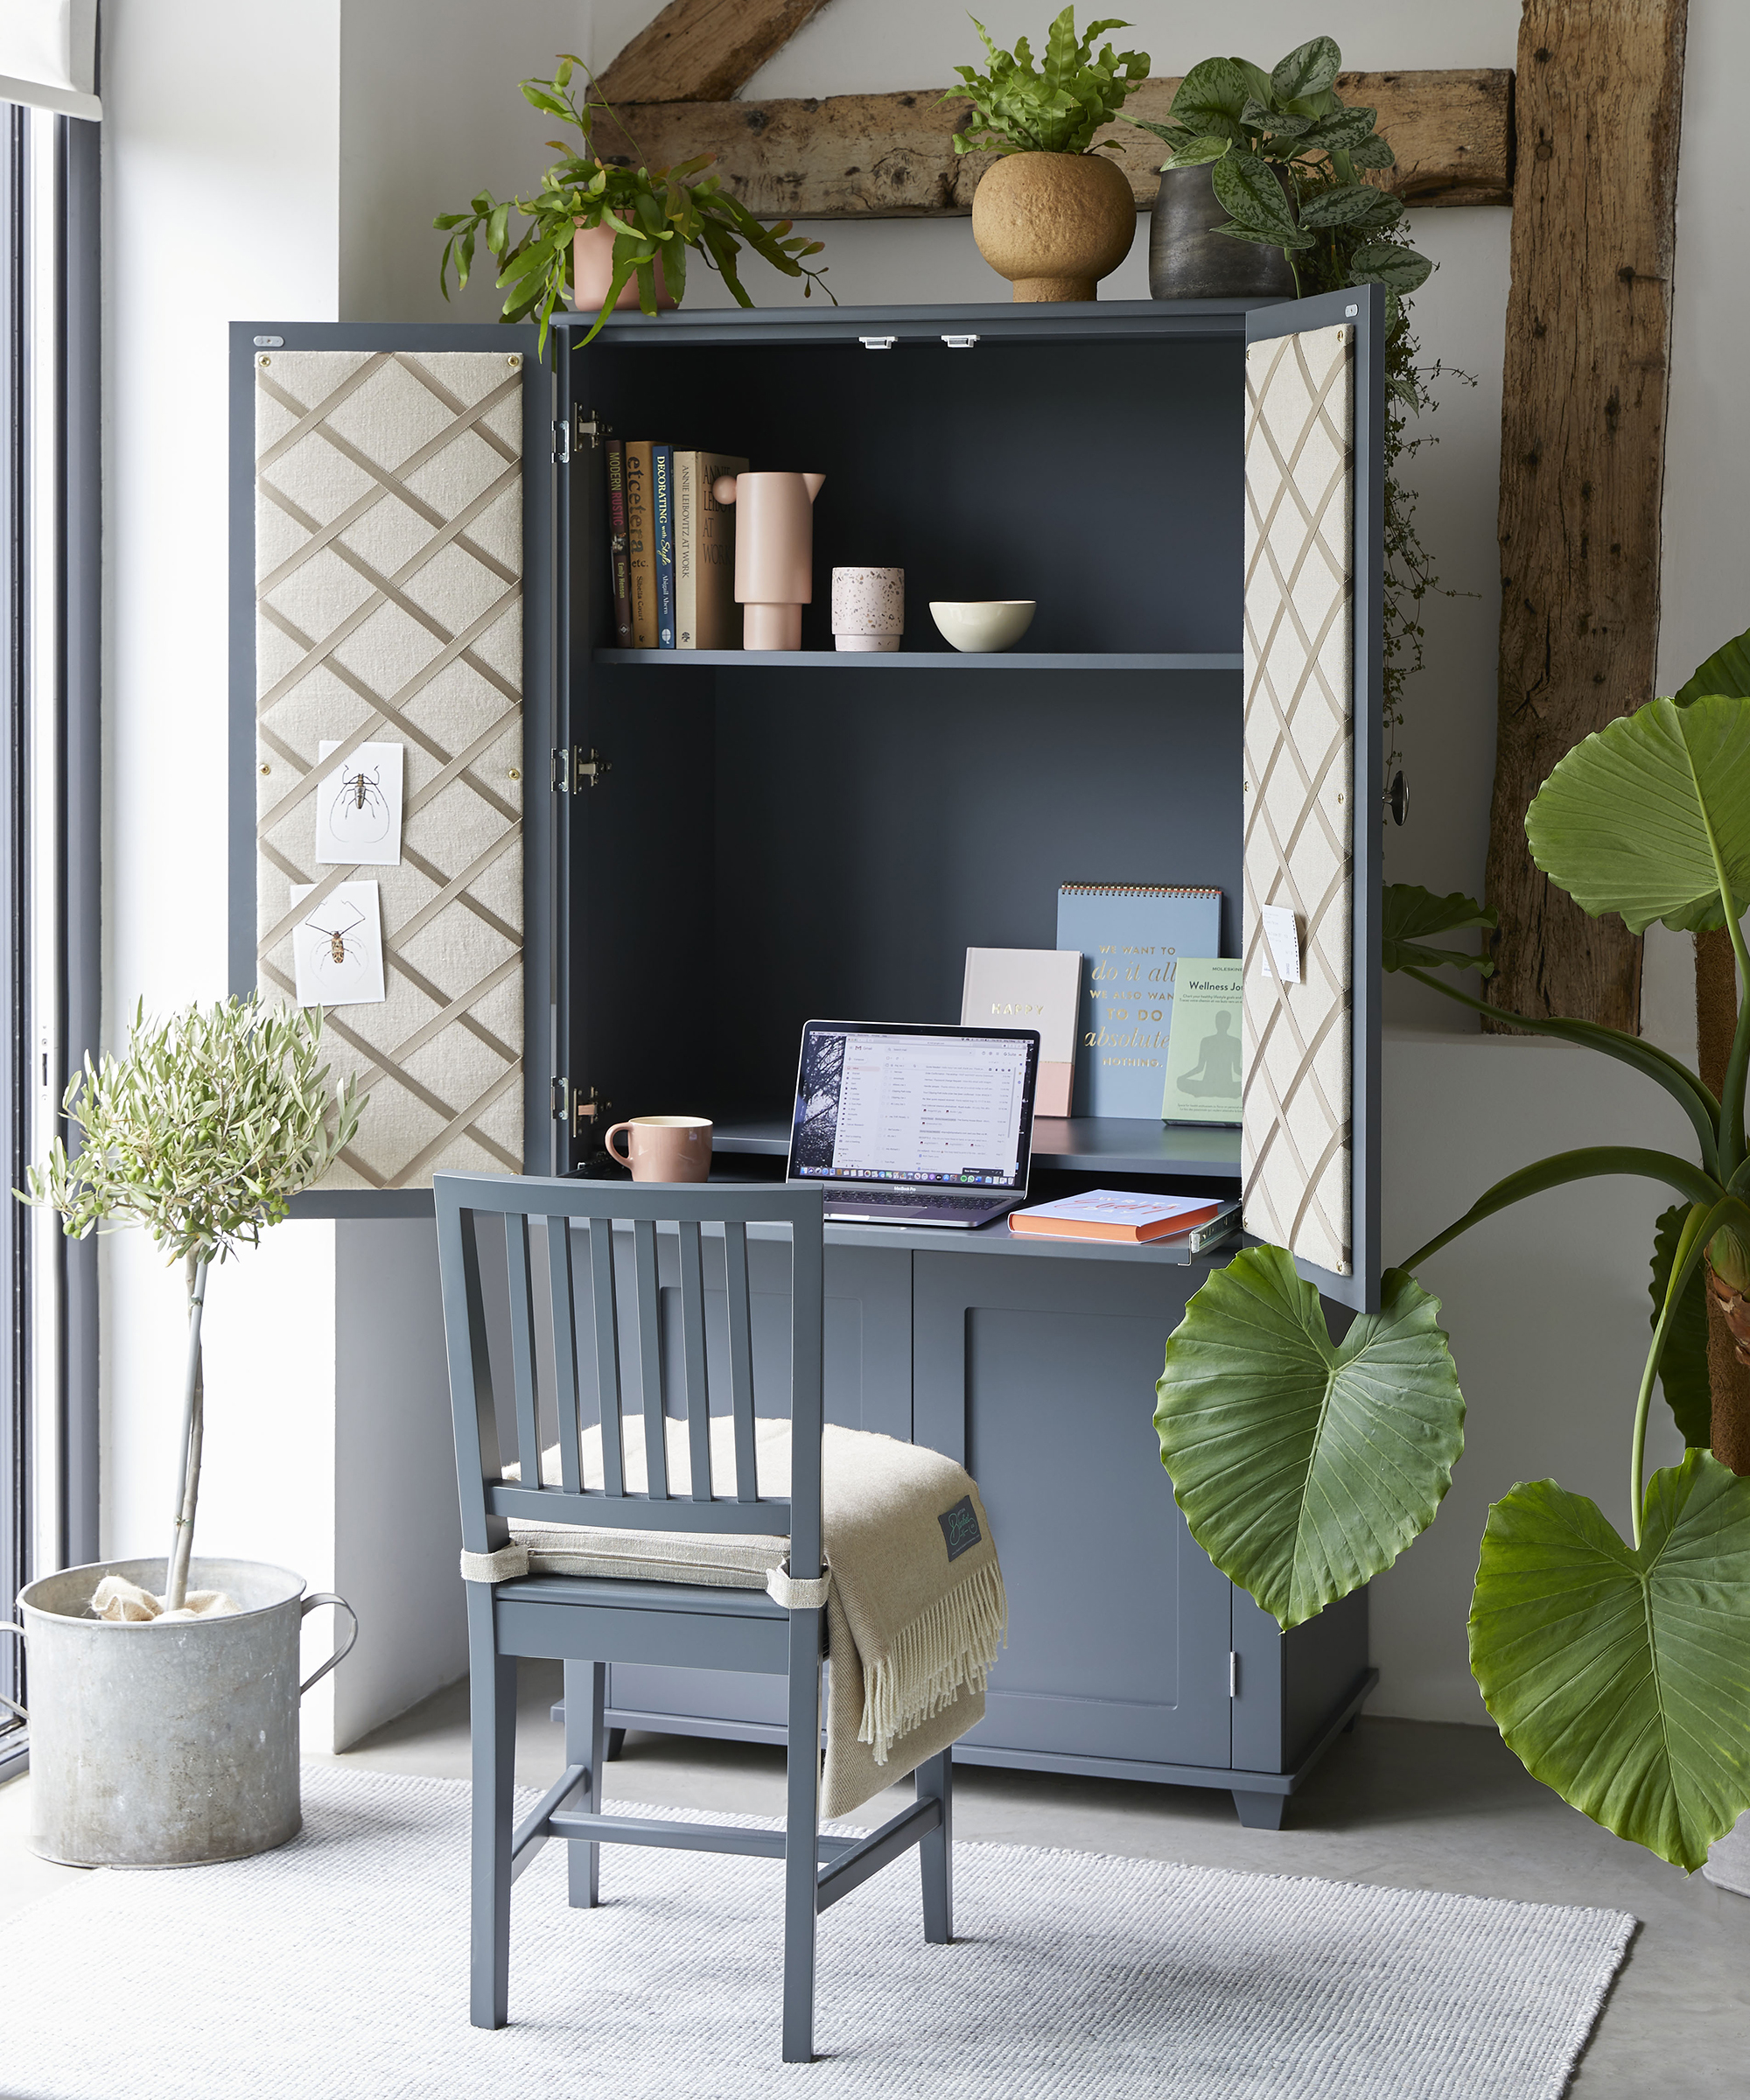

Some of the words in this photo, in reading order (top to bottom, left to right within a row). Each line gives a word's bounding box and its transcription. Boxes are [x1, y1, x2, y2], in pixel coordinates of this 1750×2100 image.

[609, 452, 621, 490] MODERN
[657, 456, 668, 524] DECORATING
[612, 492, 624, 525] RUSTIC
[627, 456, 646, 554] etcetera
[703, 518, 714, 538] AT
[657, 539, 671, 566] Style
[682, 538, 689, 549] AT
[631, 559, 649, 567] etc.
[703, 543, 732, 565] WORK
[1099, 945, 1116, 954] WE
[1161, 947, 1176, 955] TO
[1092, 960, 1118, 980] do
[1125, 961, 1141, 981] it
[1148, 962, 1177, 982] all
[1089, 990, 1107, 998] WE
[1113, 991, 1142, 1000] ALSO
[1190, 981, 1228, 991] Wellness
[992, 1003, 1044, 1016] HAPPY
[1106, 1008, 1128, 1020] TO
[1138, 1009, 1163, 1022] DO
[1085, 1026, 1170, 1049] absolute
[1103, 1057, 1163, 1068] NOTHING.
